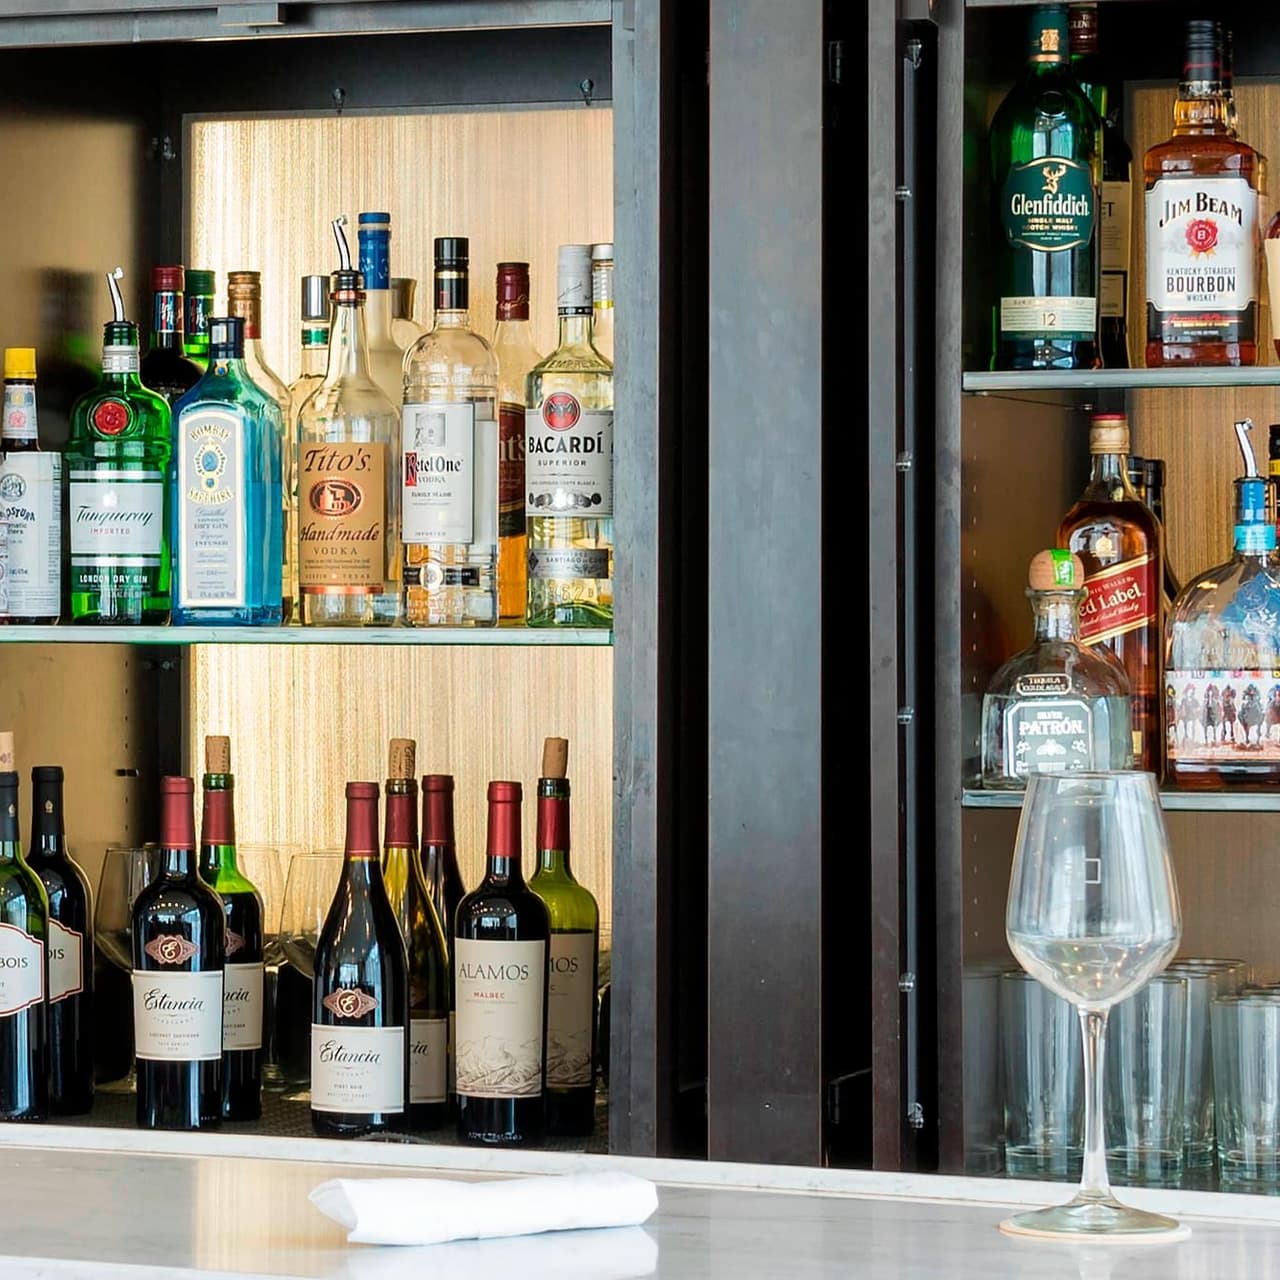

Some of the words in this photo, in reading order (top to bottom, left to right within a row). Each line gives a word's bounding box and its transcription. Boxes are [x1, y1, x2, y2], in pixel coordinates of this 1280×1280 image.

[1011, 193, 1088, 216] Glenfiddich
[1160, 198, 1190, 227] JIM
[1196, 192, 1243, 226] BEAM
[1167, 276, 1236, 293] BOURBON
[1041, 313, 1056, 326] 12
[529, 431, 603, 454] BACARDÍ
[435, 457, 460, 472] One
[538, 459, 586, 467] SUPERIOR
[77, 506, 153, 526] Tanqueray
[301, 522, 379, 542] Handmade
[313, 547, 358, 555] VODKA
[80, 575, 109, 583] LONDON
[113, 575, 130, 583] DRY
[134, 575, 147, 584] GIN
[1079, 599, 1097, 616] ed
[459, 964, 529, 982] ALAMOS
[144, 988, 205, 1012] Estancia
[319, 1039, 381, 1064] Estancia
